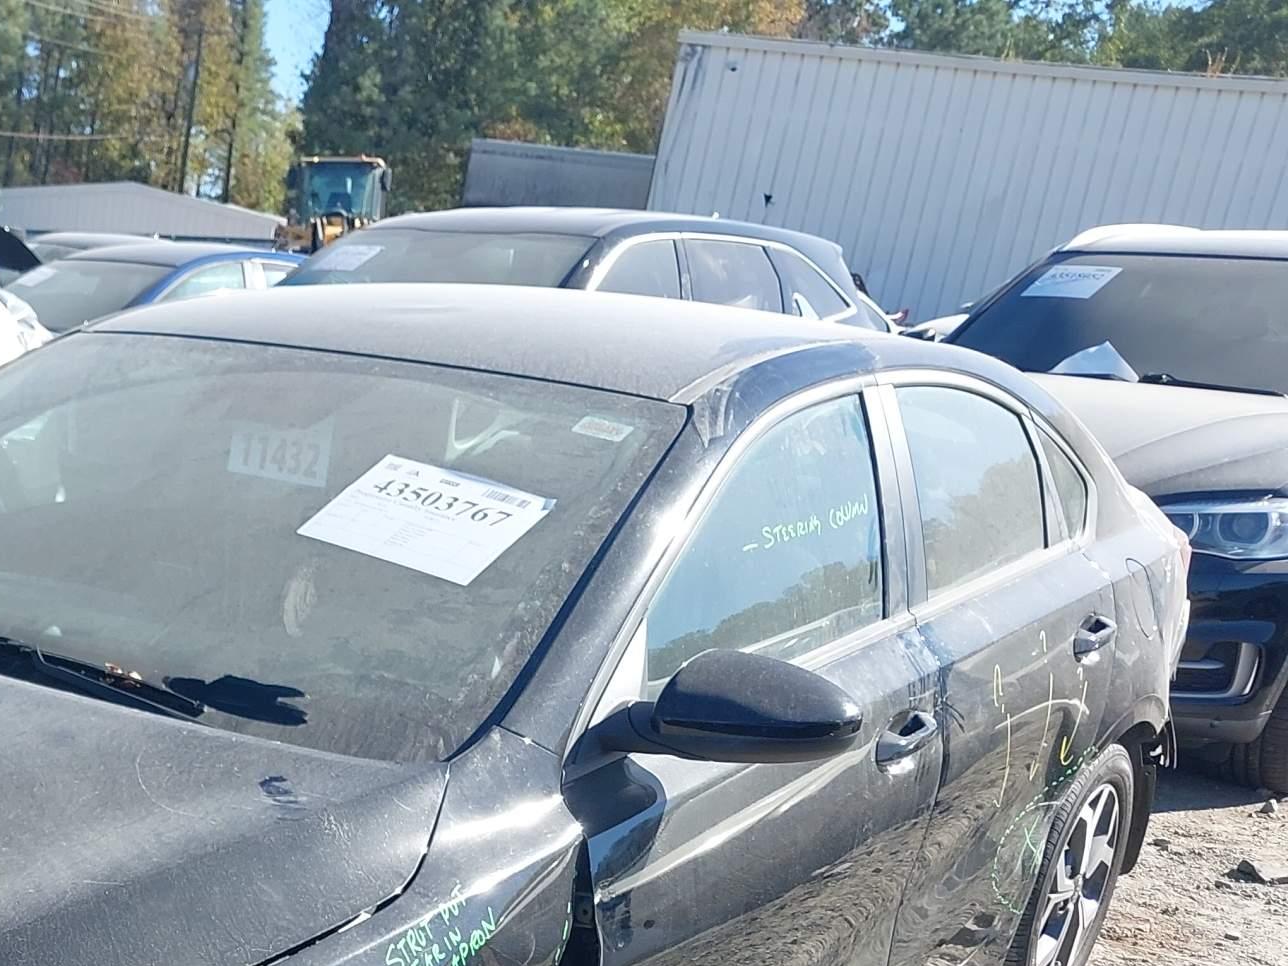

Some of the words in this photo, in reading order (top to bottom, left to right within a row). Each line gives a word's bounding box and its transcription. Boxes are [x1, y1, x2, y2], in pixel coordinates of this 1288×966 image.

[239, 434, 321, 479] 11432
[373, 479, 513, 527] 43503767
[443, 927, 462, 951] IN
